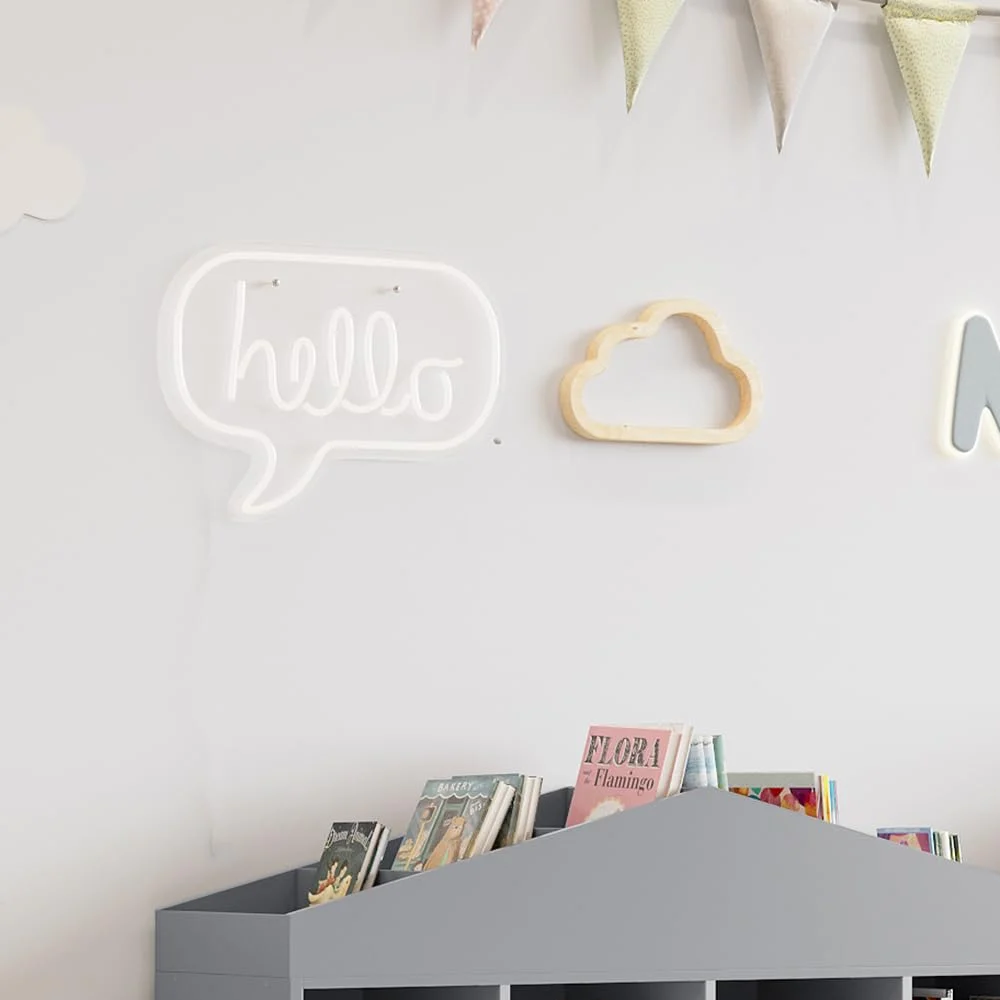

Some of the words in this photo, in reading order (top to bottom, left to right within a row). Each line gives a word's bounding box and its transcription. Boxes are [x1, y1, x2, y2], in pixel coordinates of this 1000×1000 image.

[228, 280, 463, 421] hello
[584, 735, 661, 768] FLORA
[437, 782, 473, 793] BAKERY
[594, 768, 655, 797] Flamingo
